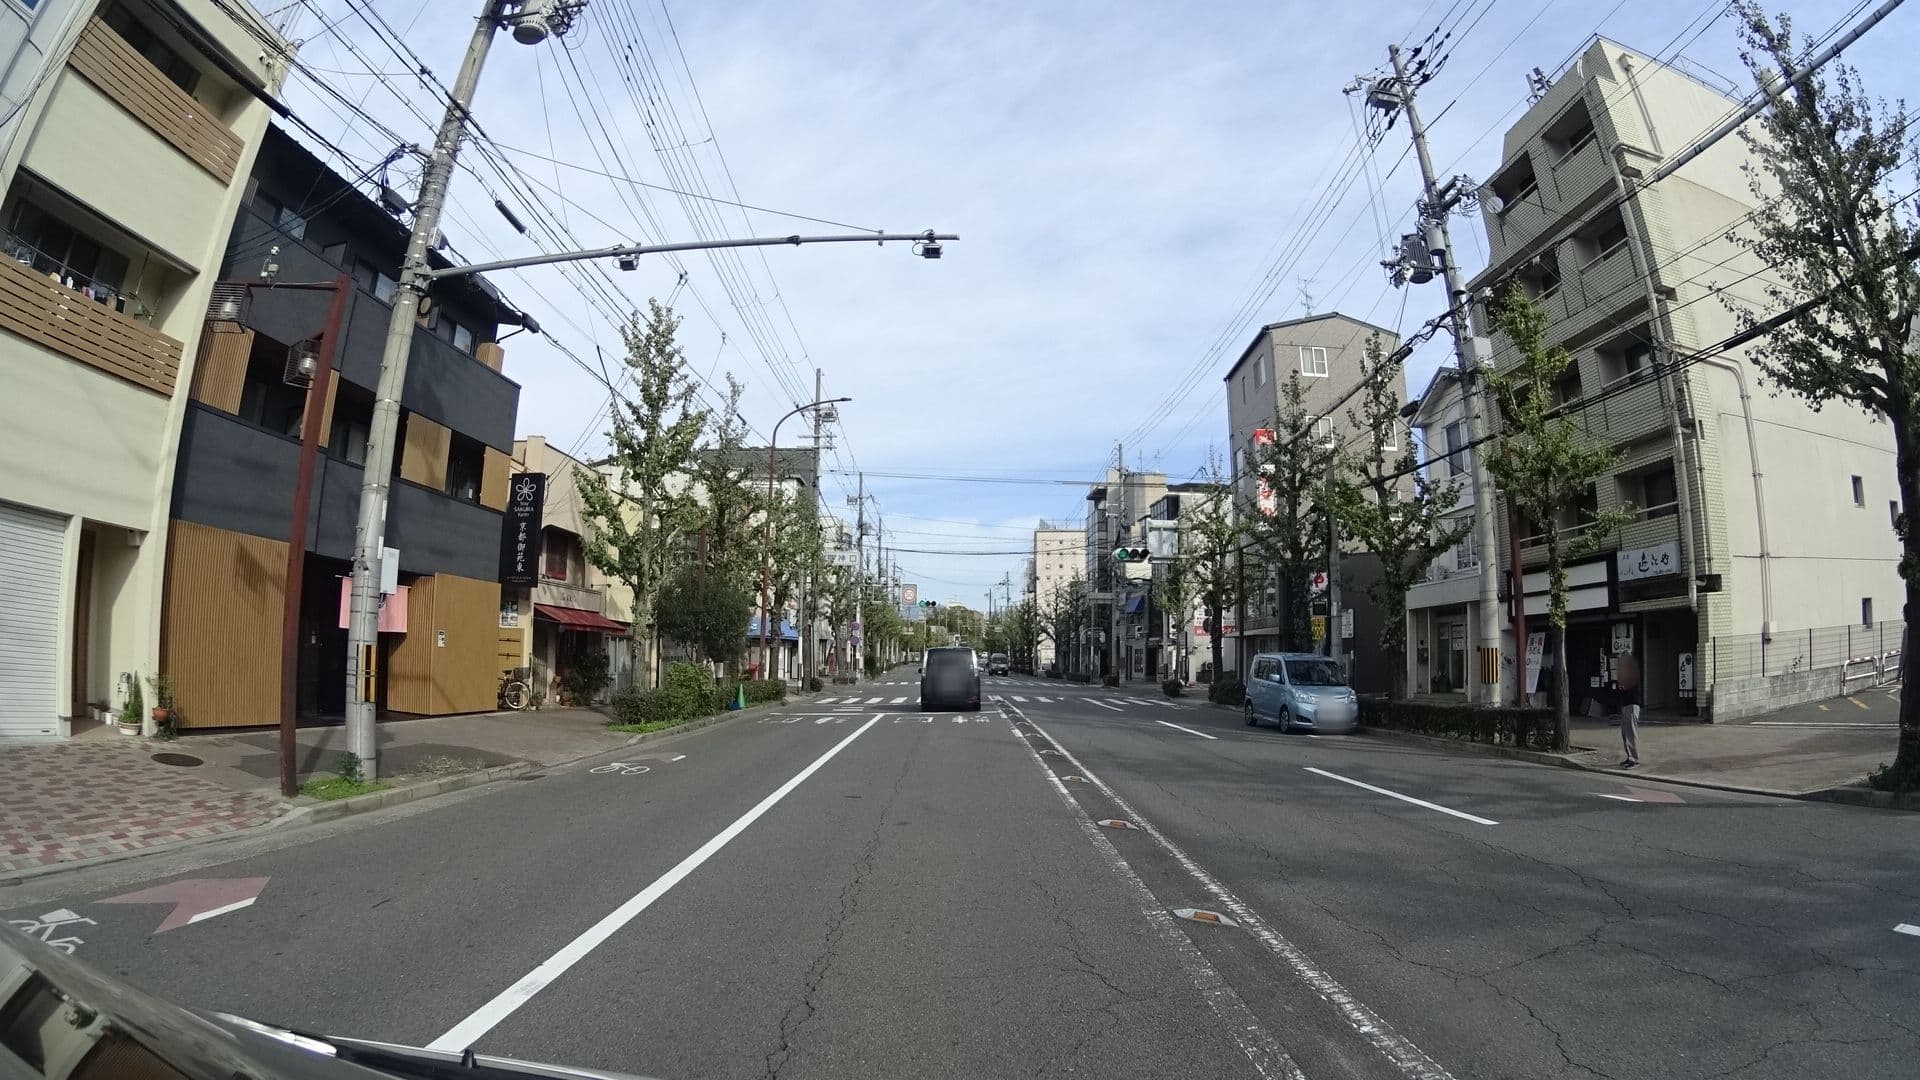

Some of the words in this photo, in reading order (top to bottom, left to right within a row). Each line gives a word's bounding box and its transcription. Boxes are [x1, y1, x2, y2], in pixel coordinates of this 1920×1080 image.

[517, 522, 527, 572] 京都御苑東
